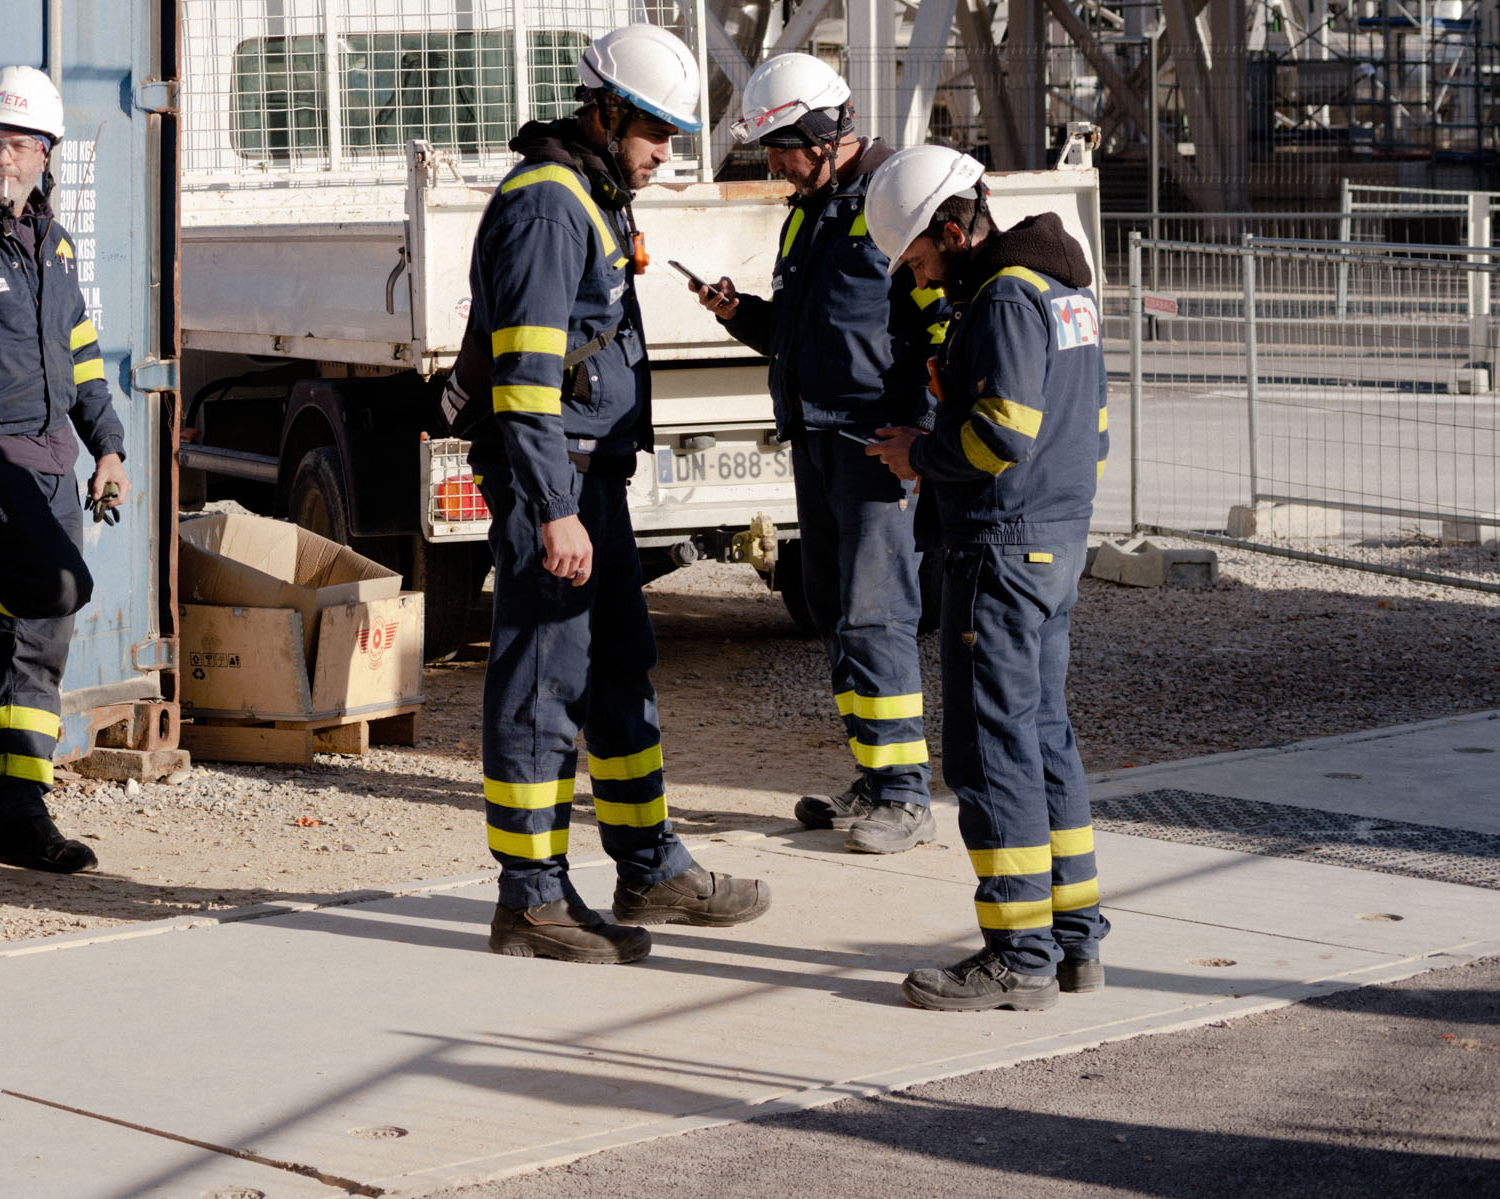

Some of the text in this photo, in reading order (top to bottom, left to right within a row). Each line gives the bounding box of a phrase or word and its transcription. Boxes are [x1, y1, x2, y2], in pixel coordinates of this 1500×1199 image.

[79, 140, 96, 161] KGS
[78, 163, 95, 184] LBS
[78, 189, 96, 211] KGS
[78, 212, 95, 233] LBS
[77, 239, 96, 260] KGS
[78, 261, 95, 282] LBS
[676, 450, 793, 482] DN-688-S
